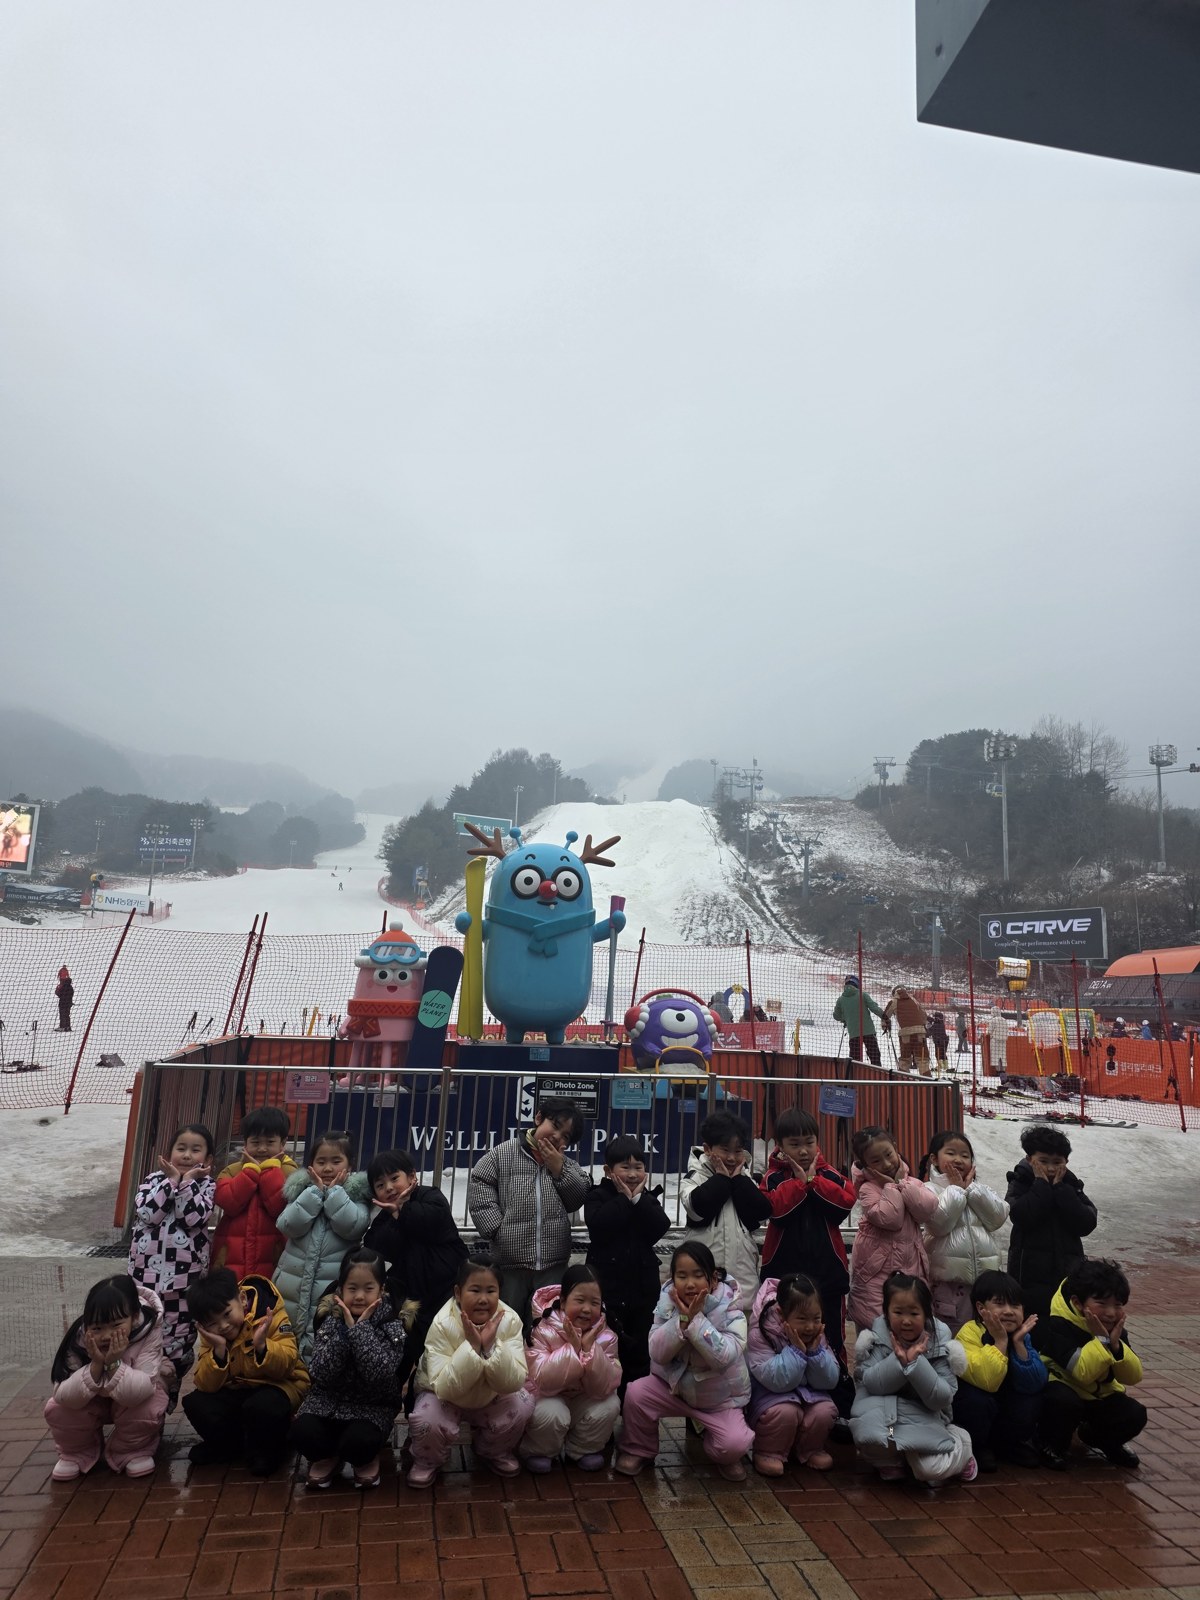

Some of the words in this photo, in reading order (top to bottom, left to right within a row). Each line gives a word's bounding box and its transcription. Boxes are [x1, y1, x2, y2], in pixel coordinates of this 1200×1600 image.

[1006, 918, 1092, 935] CARVE
[423, 1001, 446, 1010] WATER
[421, 1008, 448, 1017] PLANET
[554, 1081, 576, 1089] Photo
[577, 1082, 595, 1090] Zone
[411, 1126, 497, 1151] WELLI
[591, 1128, 660, 1154] PK
